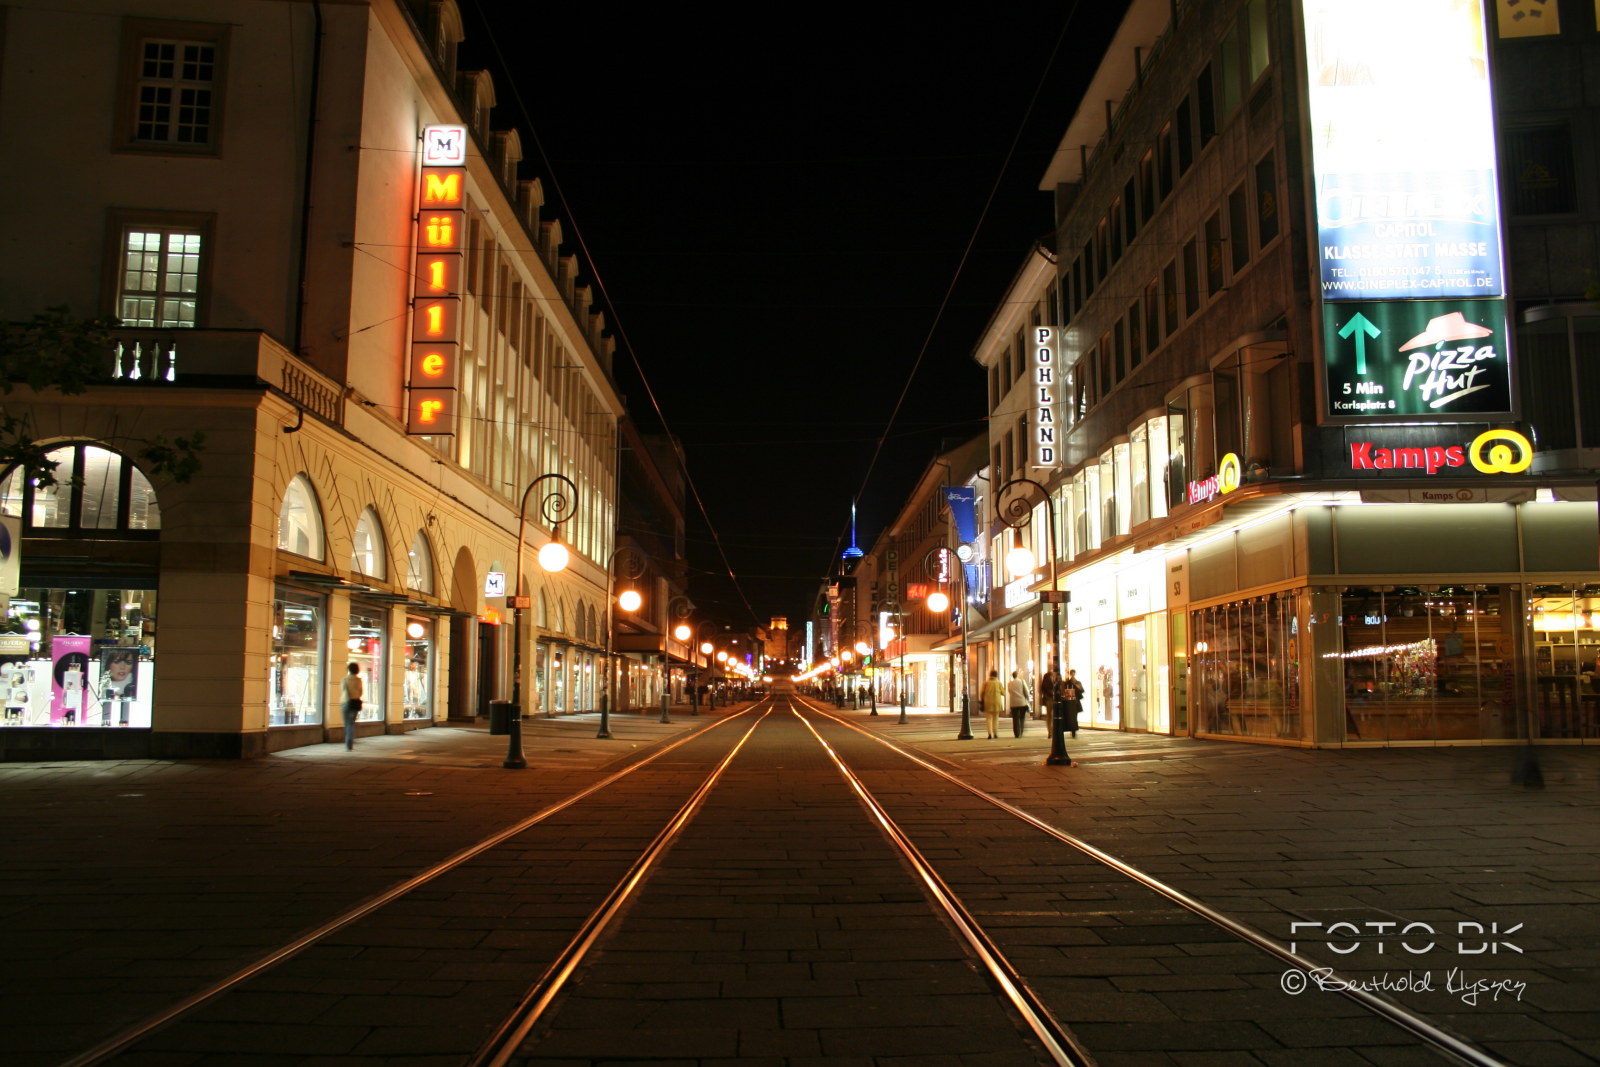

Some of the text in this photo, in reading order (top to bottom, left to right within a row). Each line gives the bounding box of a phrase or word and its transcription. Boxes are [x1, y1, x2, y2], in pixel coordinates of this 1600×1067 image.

[1375, 222, 1437, 238] CAPITOL
[1324, 242, 1488, 260] KLASSE STATT MASSE
[420, 173, 460, 422] Müller
[1403, 340, 1496, 390] Pizza
[1038, 328, 1053, 463] POHLAND
[1342, 382, 1384, 395] 5 Min
[1419, 365, 1488, 401] Hut
[1334, 400, 1396, 411] Karlsplatz 8
[1351, 442, 1466, 475] Kamps
[1188, 474, 1221, 505] Kamps
[1422, 491, 1454, 502] Kamps
